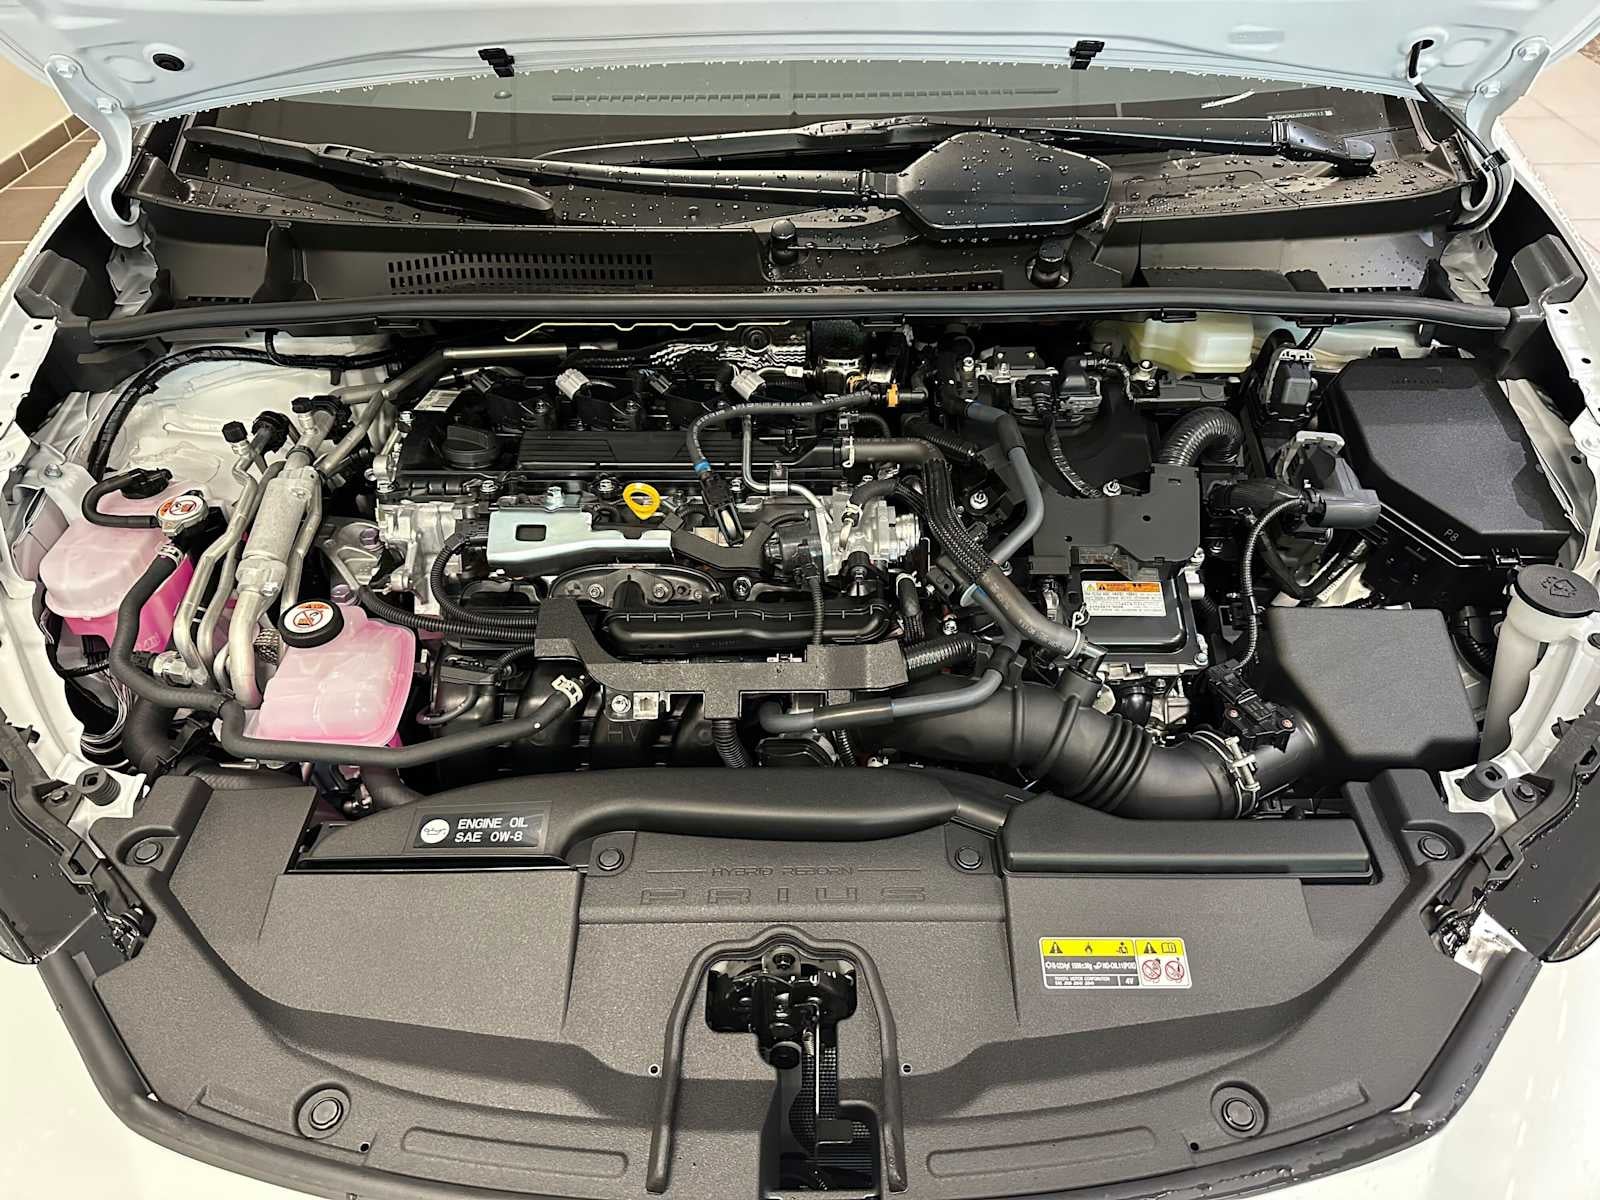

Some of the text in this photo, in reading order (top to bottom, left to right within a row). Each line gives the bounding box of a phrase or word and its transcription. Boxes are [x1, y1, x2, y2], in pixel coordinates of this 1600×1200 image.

[1443, 529, 1459, 542] P8
[607, 723, 641, 743] HV
[457, 816, 528, 830] ENGINE OIL
[454, 831, 523, 843] SAE 0W-8
[711, 866, 853, 877] HYBRID REBORN
[640, 887, 926, 904] PRIUS
